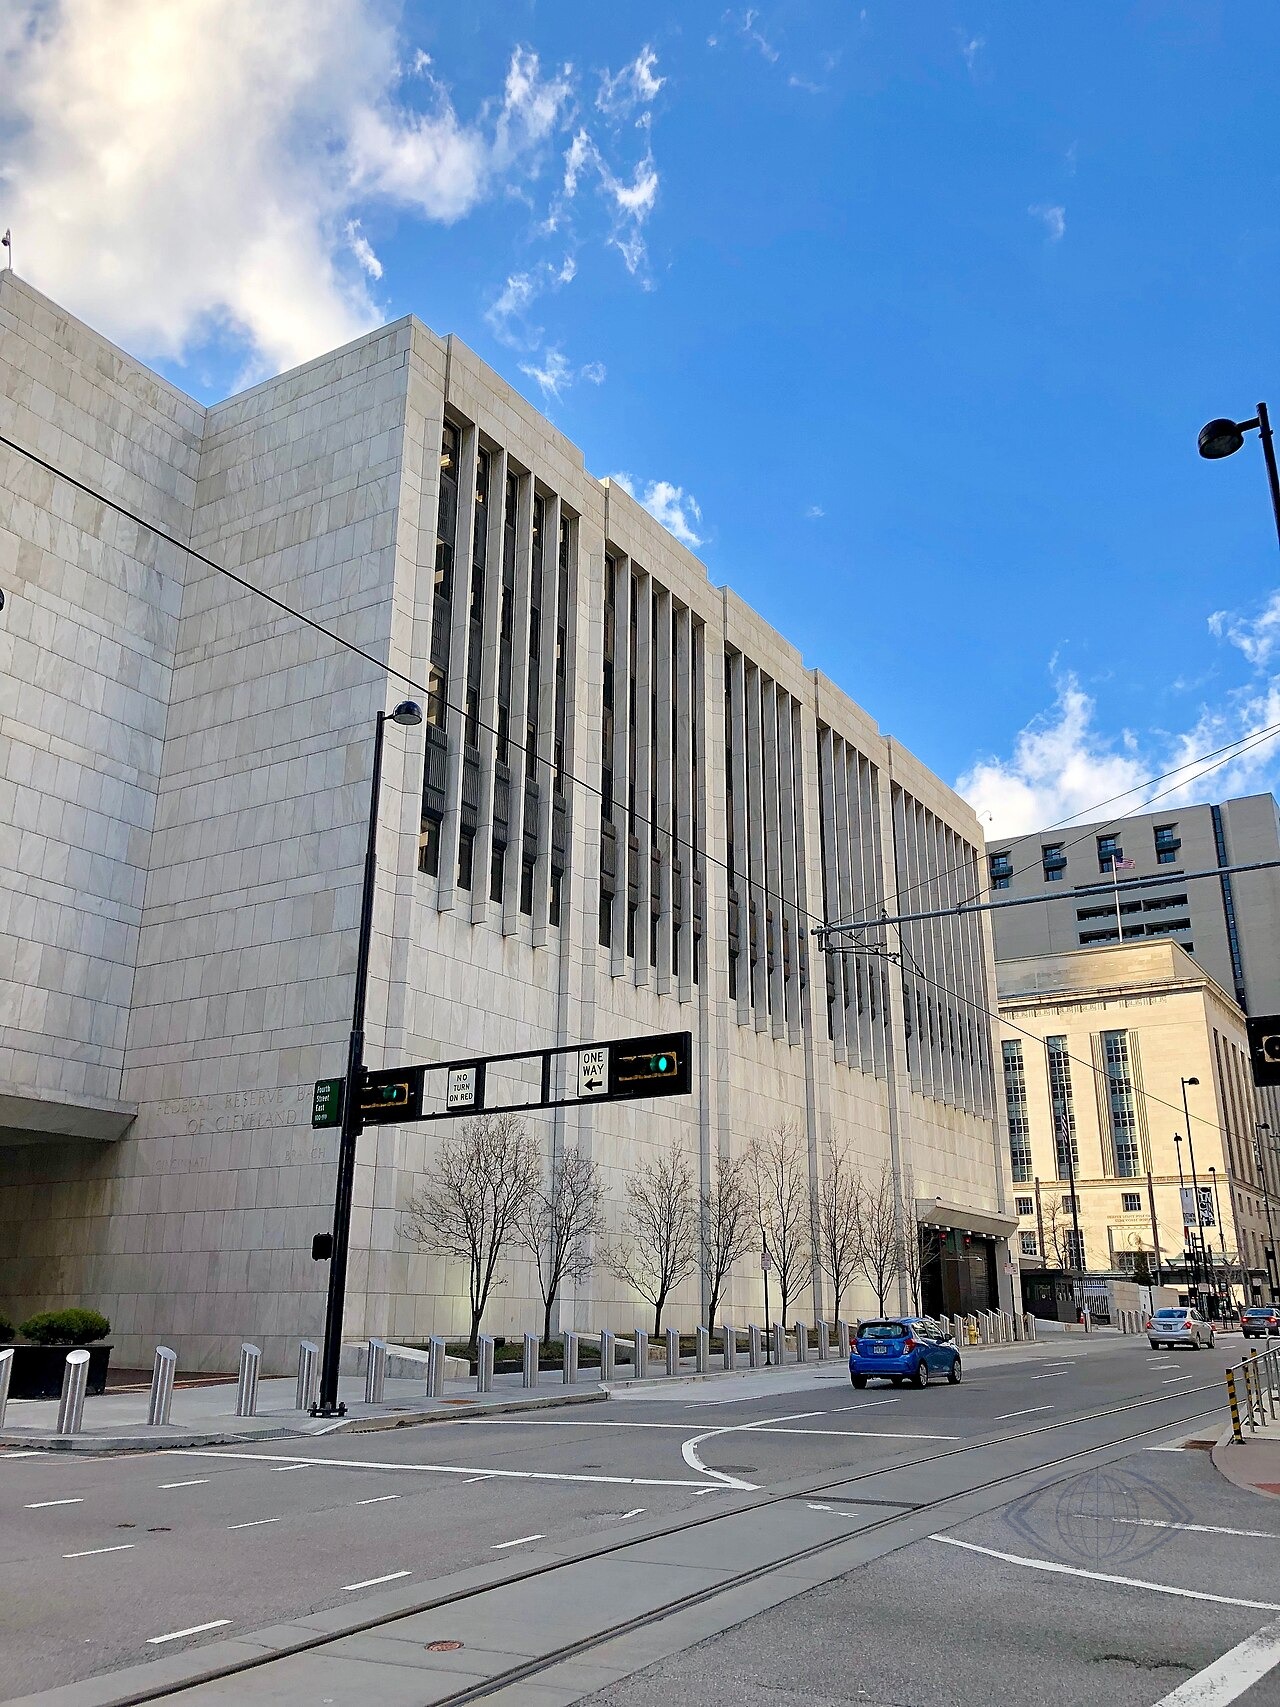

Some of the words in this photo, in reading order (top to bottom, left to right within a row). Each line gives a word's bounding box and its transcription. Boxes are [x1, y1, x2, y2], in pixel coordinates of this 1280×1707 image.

[583, 1051, 604, 1064] ONE
[582, 1063, 605, 1077] WAY
[456, 1073, 468, 1082] NO
[317, 1085, 331, 1093] Fourth
[453, 1082, 470, 1092] TURN
[156, 1096, 214, 1116] FEDERAL
[224, 1088, 284, 1110] RESERVE
[316, 1094, 330, 1102] Street
[449, 1094, 459, 1102] ON
[460, 1092, 473, 1101] RED
[315, 1104, 325, 1112] East
[187, 1117, 206, 1134] OF
[215, 1109, 298, 1132] CLEVELAND
